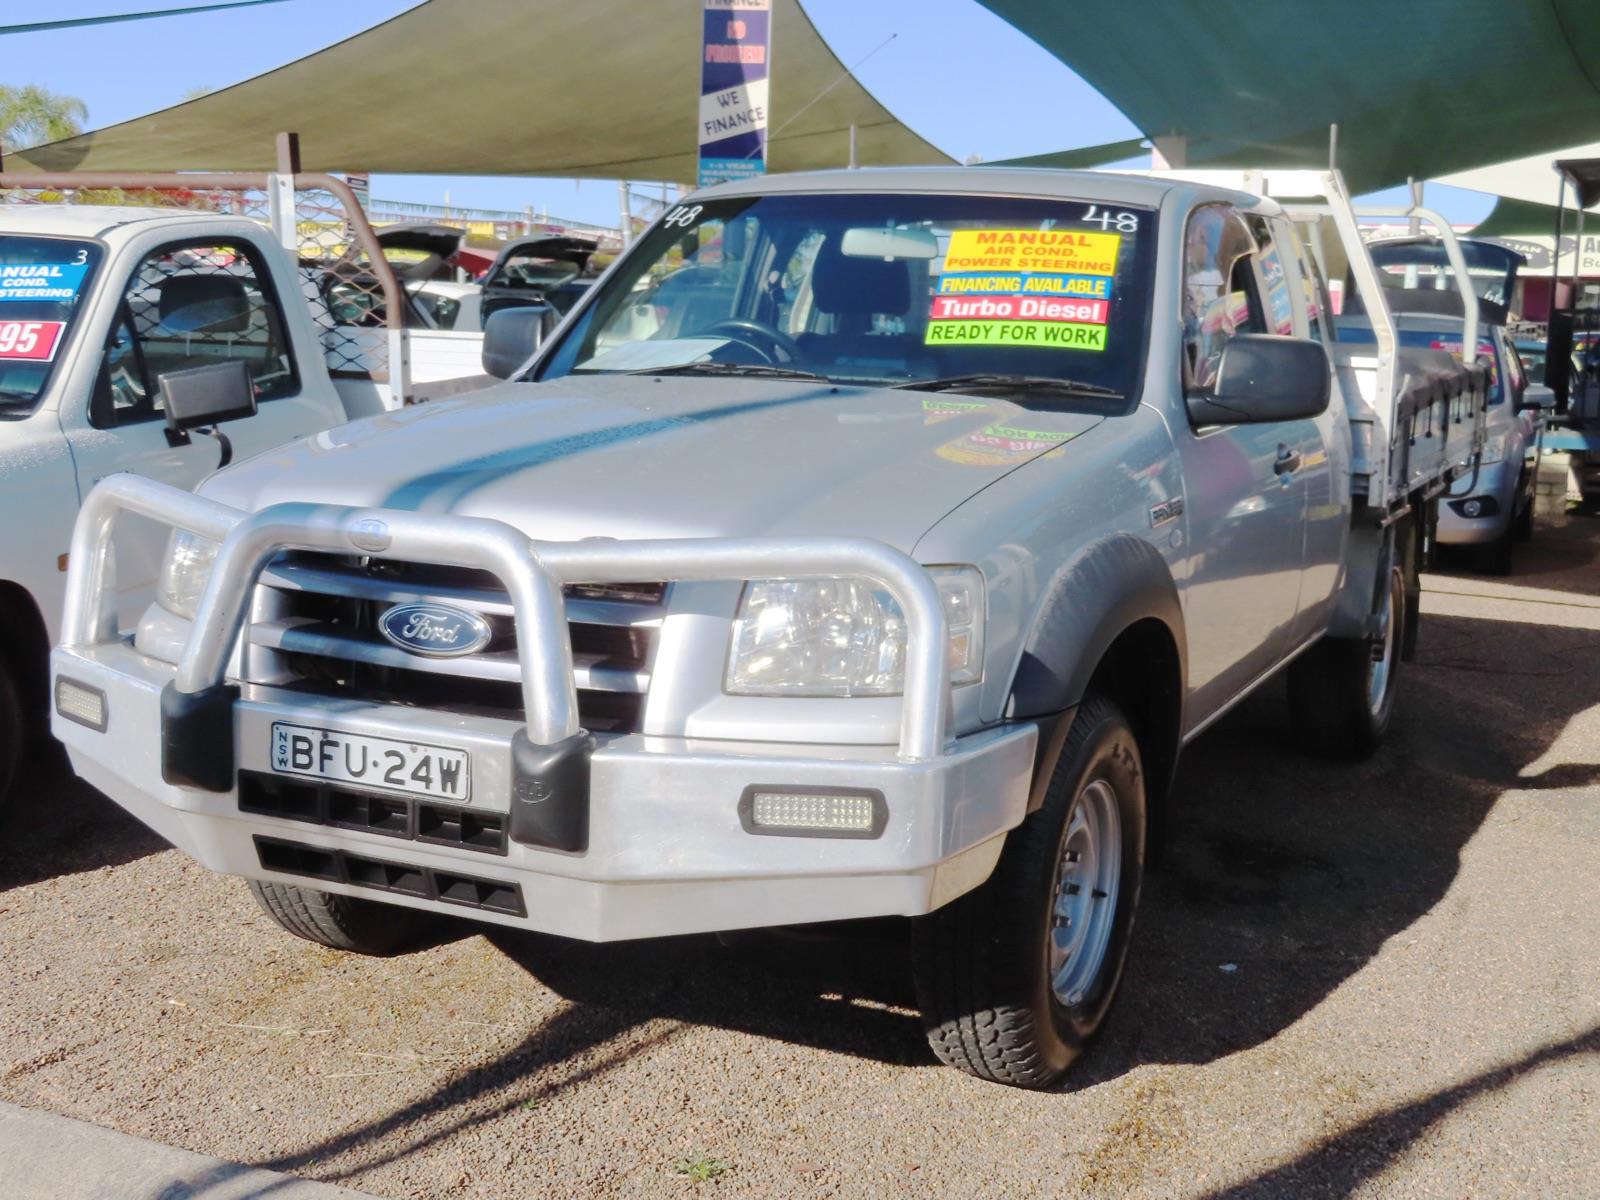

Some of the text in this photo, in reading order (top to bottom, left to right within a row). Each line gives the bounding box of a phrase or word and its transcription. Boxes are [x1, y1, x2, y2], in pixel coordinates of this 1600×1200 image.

[717, 91, 740, 109] WE
[704, 106, 765, 136] FINANCE
[664, 205, 703, 228] 48
[1081, 205, 1138, 232] 48
[976, 232, 1093, 248] MANUAL
[71, 250, 88, 265] 3
[984, 246, 1078, 258] AIR COND.
[947, 258, 1111, 272] POWER STEERING
[2, 278, 49, 287] COND.
[940, 277, 1107, 295] FINANCING AVAILABLE
[0, 288, 74, 298] STEERING
[940, 299, 1101, 321] Turbo Diesel
[0, 323, 43, 353] 95
[931, 324, 1101, 345] READY FOR WORK
[402, 612, 461, 643] Ford
